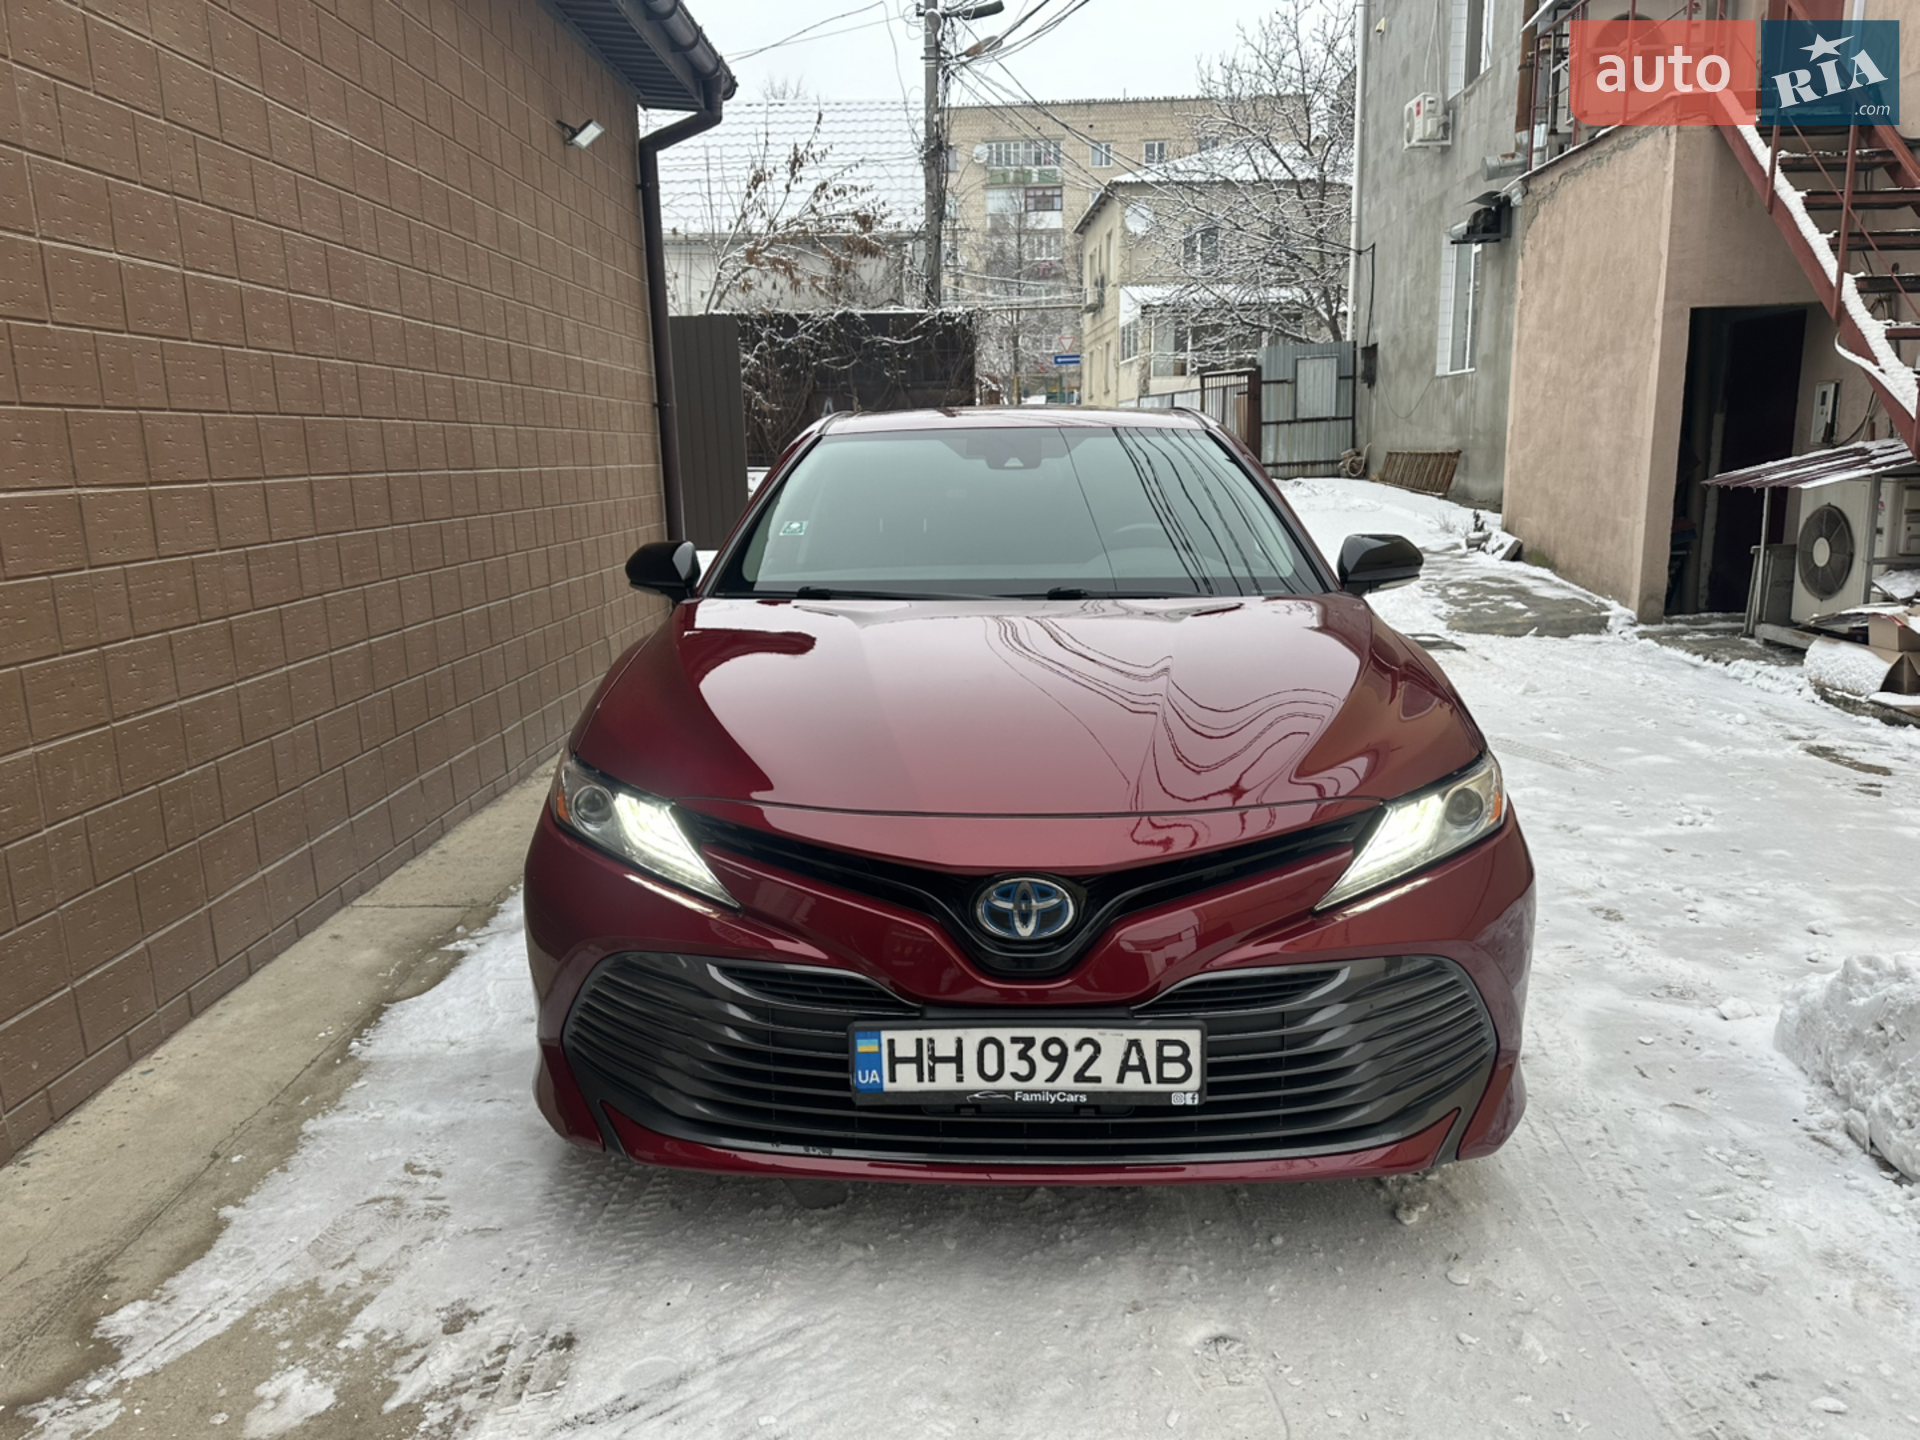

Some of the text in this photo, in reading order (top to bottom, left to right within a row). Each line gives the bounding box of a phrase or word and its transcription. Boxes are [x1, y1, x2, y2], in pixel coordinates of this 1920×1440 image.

[887, 1036, 1193, 1085] HH 0392 AB
[858, 1069, 880, 1084] UA
[1014, 1091, 1088, 1103] FamilyCars
